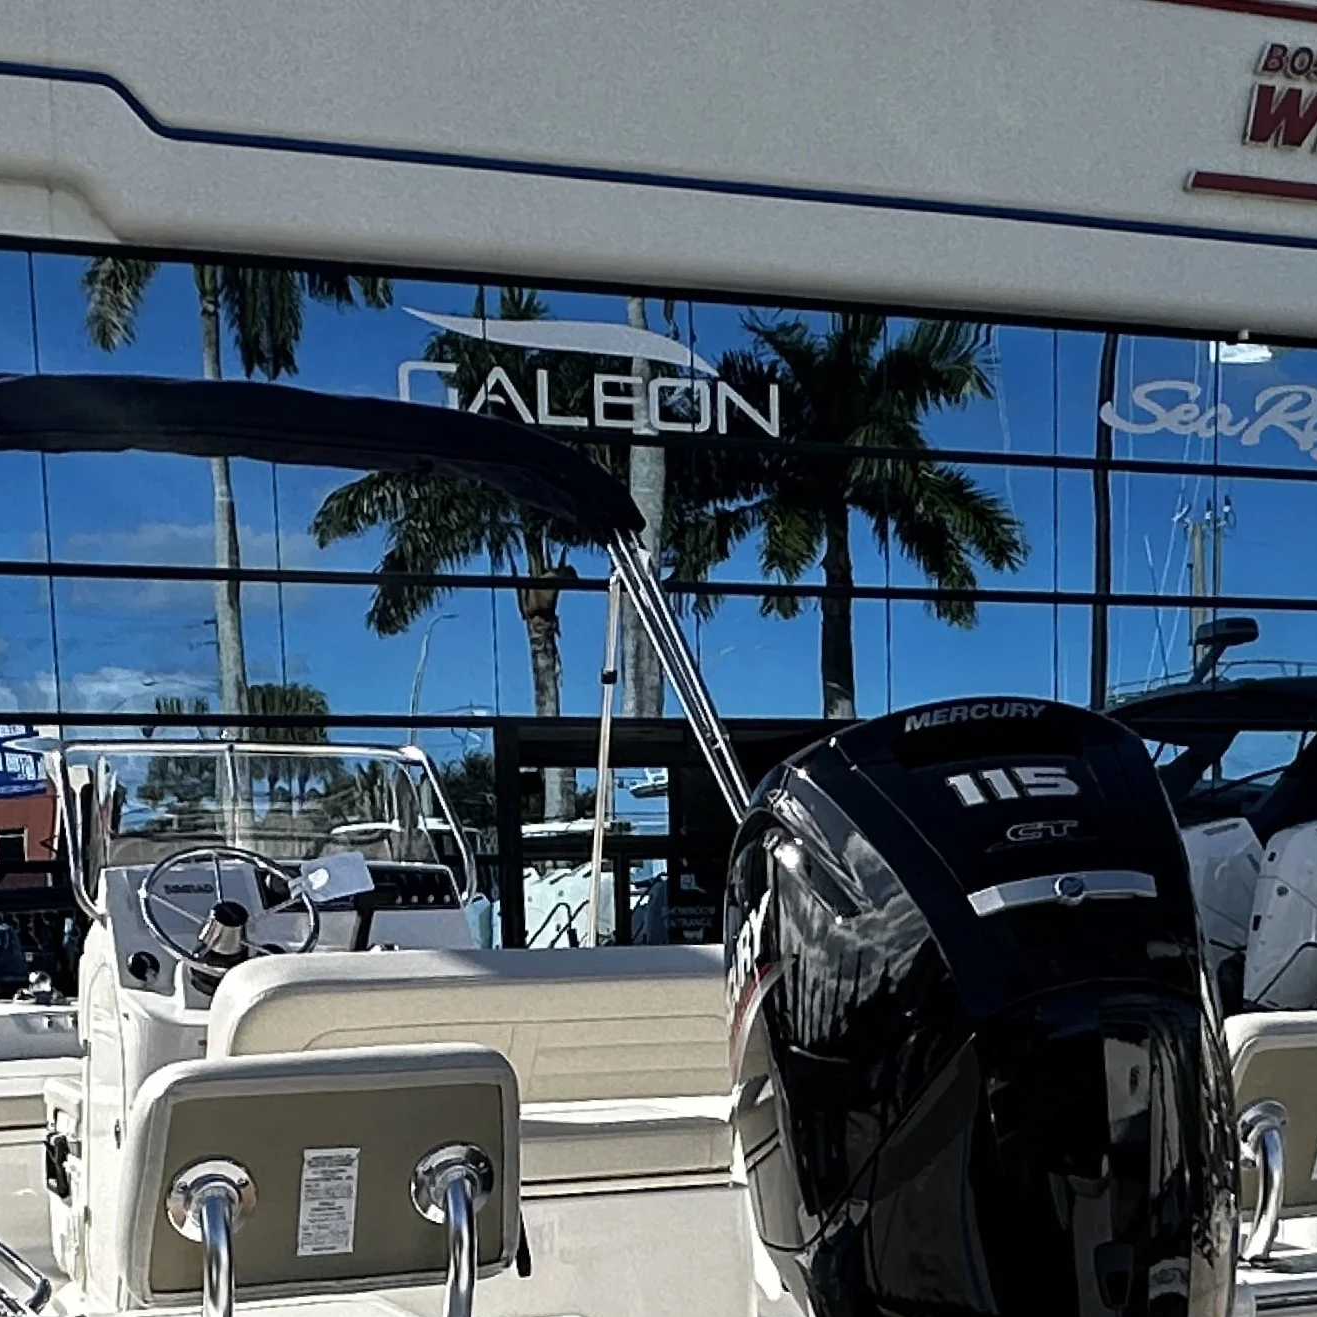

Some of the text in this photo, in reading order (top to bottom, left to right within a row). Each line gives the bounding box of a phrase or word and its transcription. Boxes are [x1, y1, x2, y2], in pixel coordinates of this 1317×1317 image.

[397, 360, 780, 438] GALEON
[1099, 379, 1249, 438] Sea
[903, 701, 1047, 733] MERCURY
[945, 765, 1079, 807] 115
[1006, 819, 1079, 842] GT
